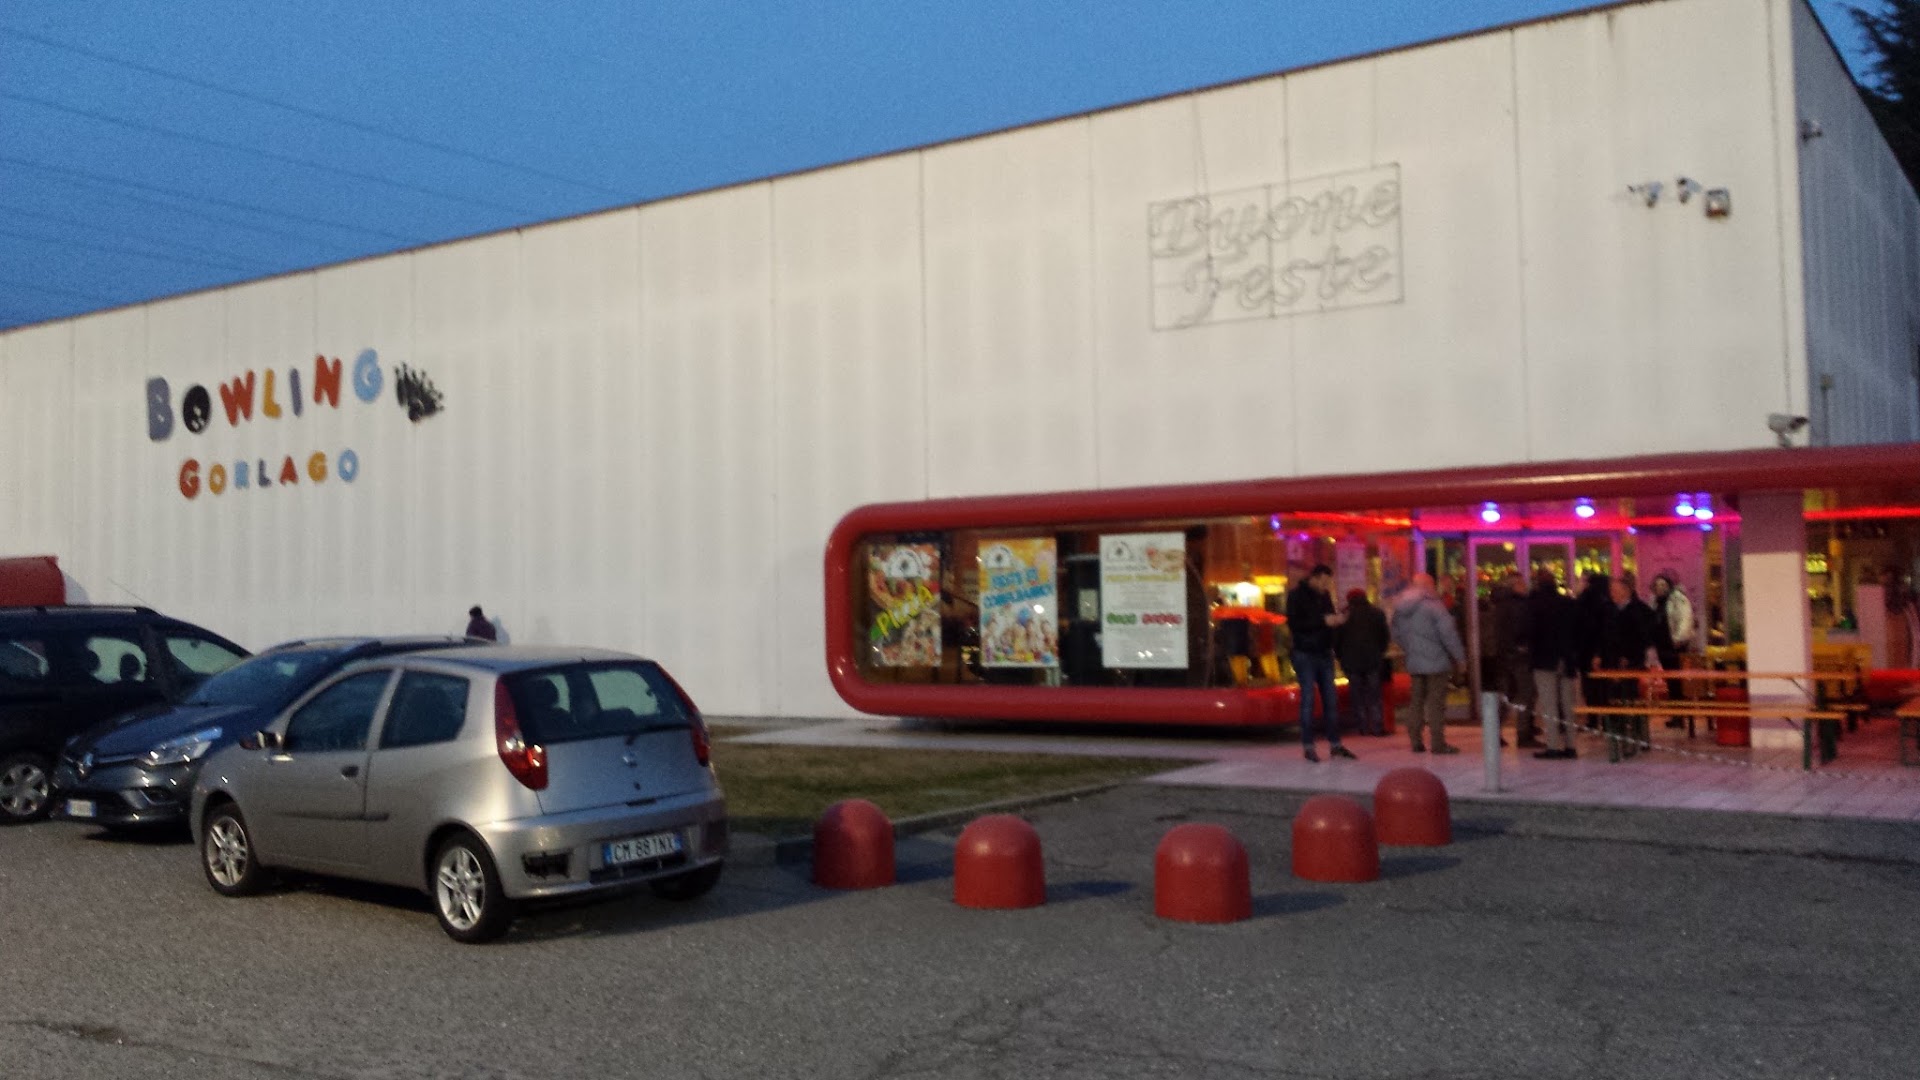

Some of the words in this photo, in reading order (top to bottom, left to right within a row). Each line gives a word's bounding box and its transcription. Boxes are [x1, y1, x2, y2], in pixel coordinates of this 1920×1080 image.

[1149, 179, 1399, 258] Buone
[1176, 245, 1392, 328] Feste
[147, 348, 383, 441] BOWLING
[179, 449, 358, 499] GORLAGO
